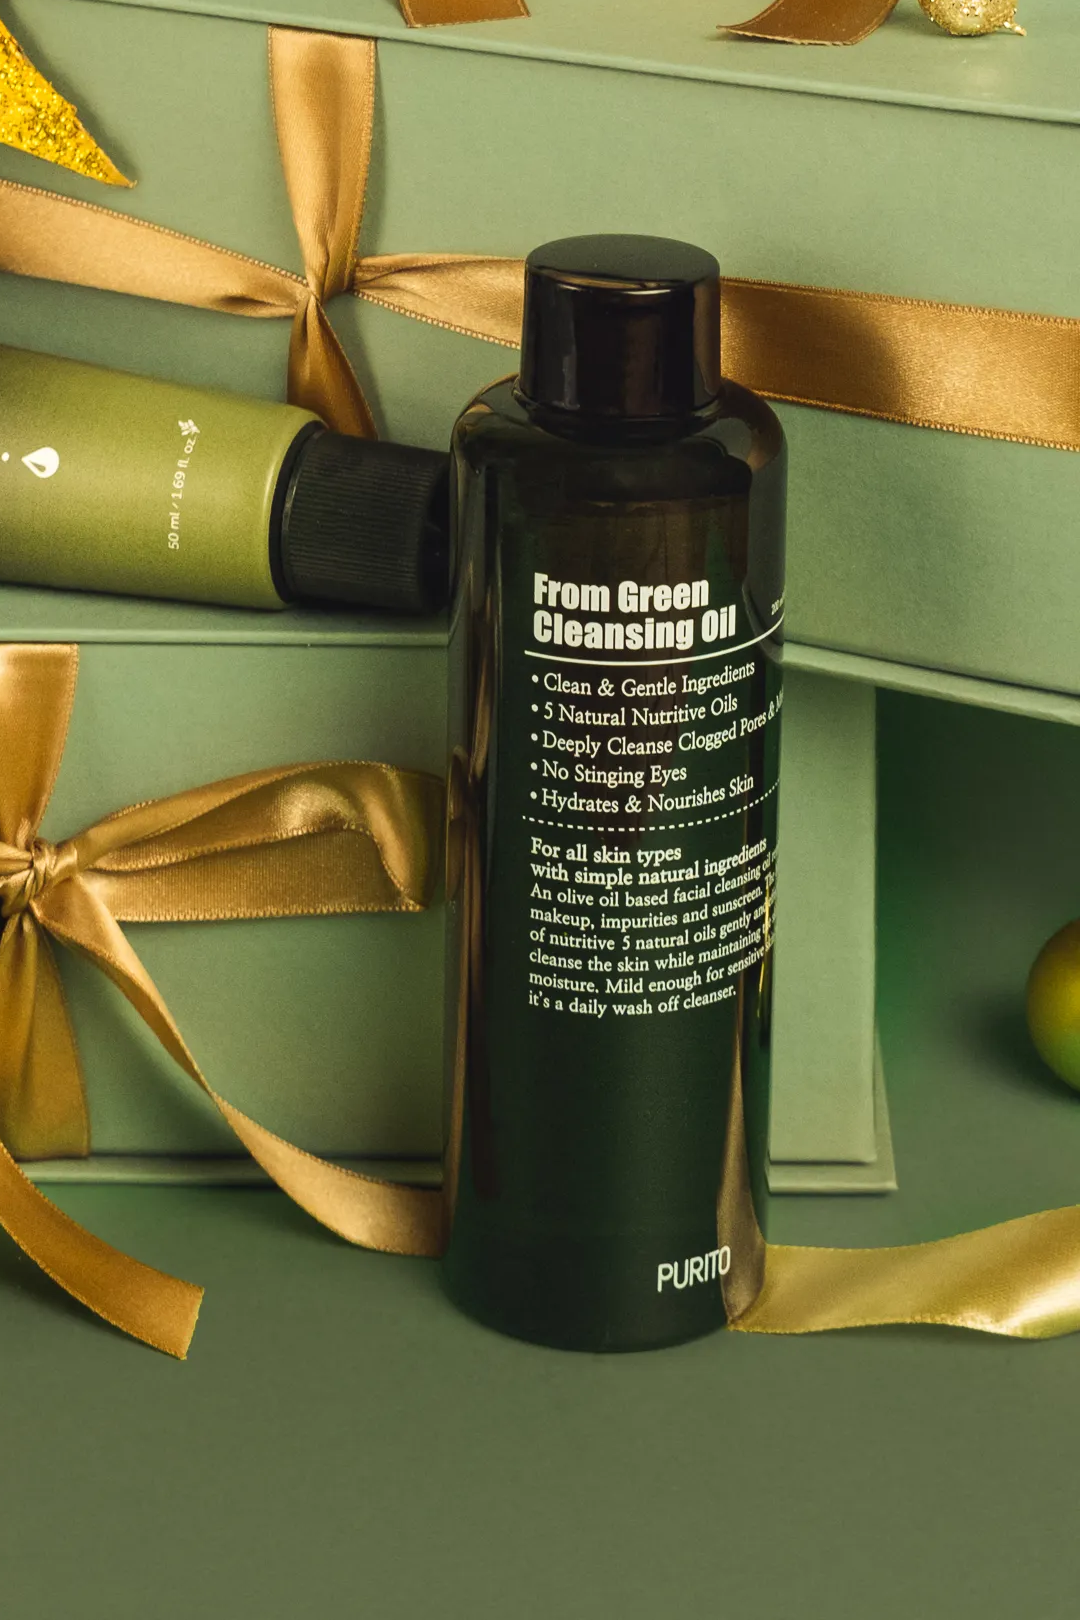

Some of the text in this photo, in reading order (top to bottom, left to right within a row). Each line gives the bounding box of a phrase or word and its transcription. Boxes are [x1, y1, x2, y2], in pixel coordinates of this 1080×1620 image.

[169, 512, 180, 529] ml
[168, 533, 179, 550] 50
[534, 572, 709, 613] From Green
[533, 610, 694, 651] Cleansing
[702, 604, 736, 642] Oil
[544, 661, 755, 697] Clean & Gentle Ingredients
[544, 693, 738, 726] 5 Natural Nutritive Oils
[543, 715, 767, 759] Deeply Cleanse Clogged Pores
[542, 773, 754, 813] Hydrates & Nourishes Skin
[543, 759, 687, 788] No Stinging Eyes
[531, 836, 682, 868] For all skin types
[531, 837, 767, 890] with simple natural ingredients
[531, 865, 760, 907] An olive oil based facial cleansing
[530, 887, 762, 933] makeup, impurities and sunscreen.
[530, 910, 751, 951] of nutritive 5 natural oils gently
[530, 927, 761, 972] cleanse the skin while maintaining
[529, 947, 764, 994] moisture. Mild enough for sensitive
[529, 984, 736, 1019] it's daily wash off cleanser.
[657, 1245, 731, 1292] PURITO
